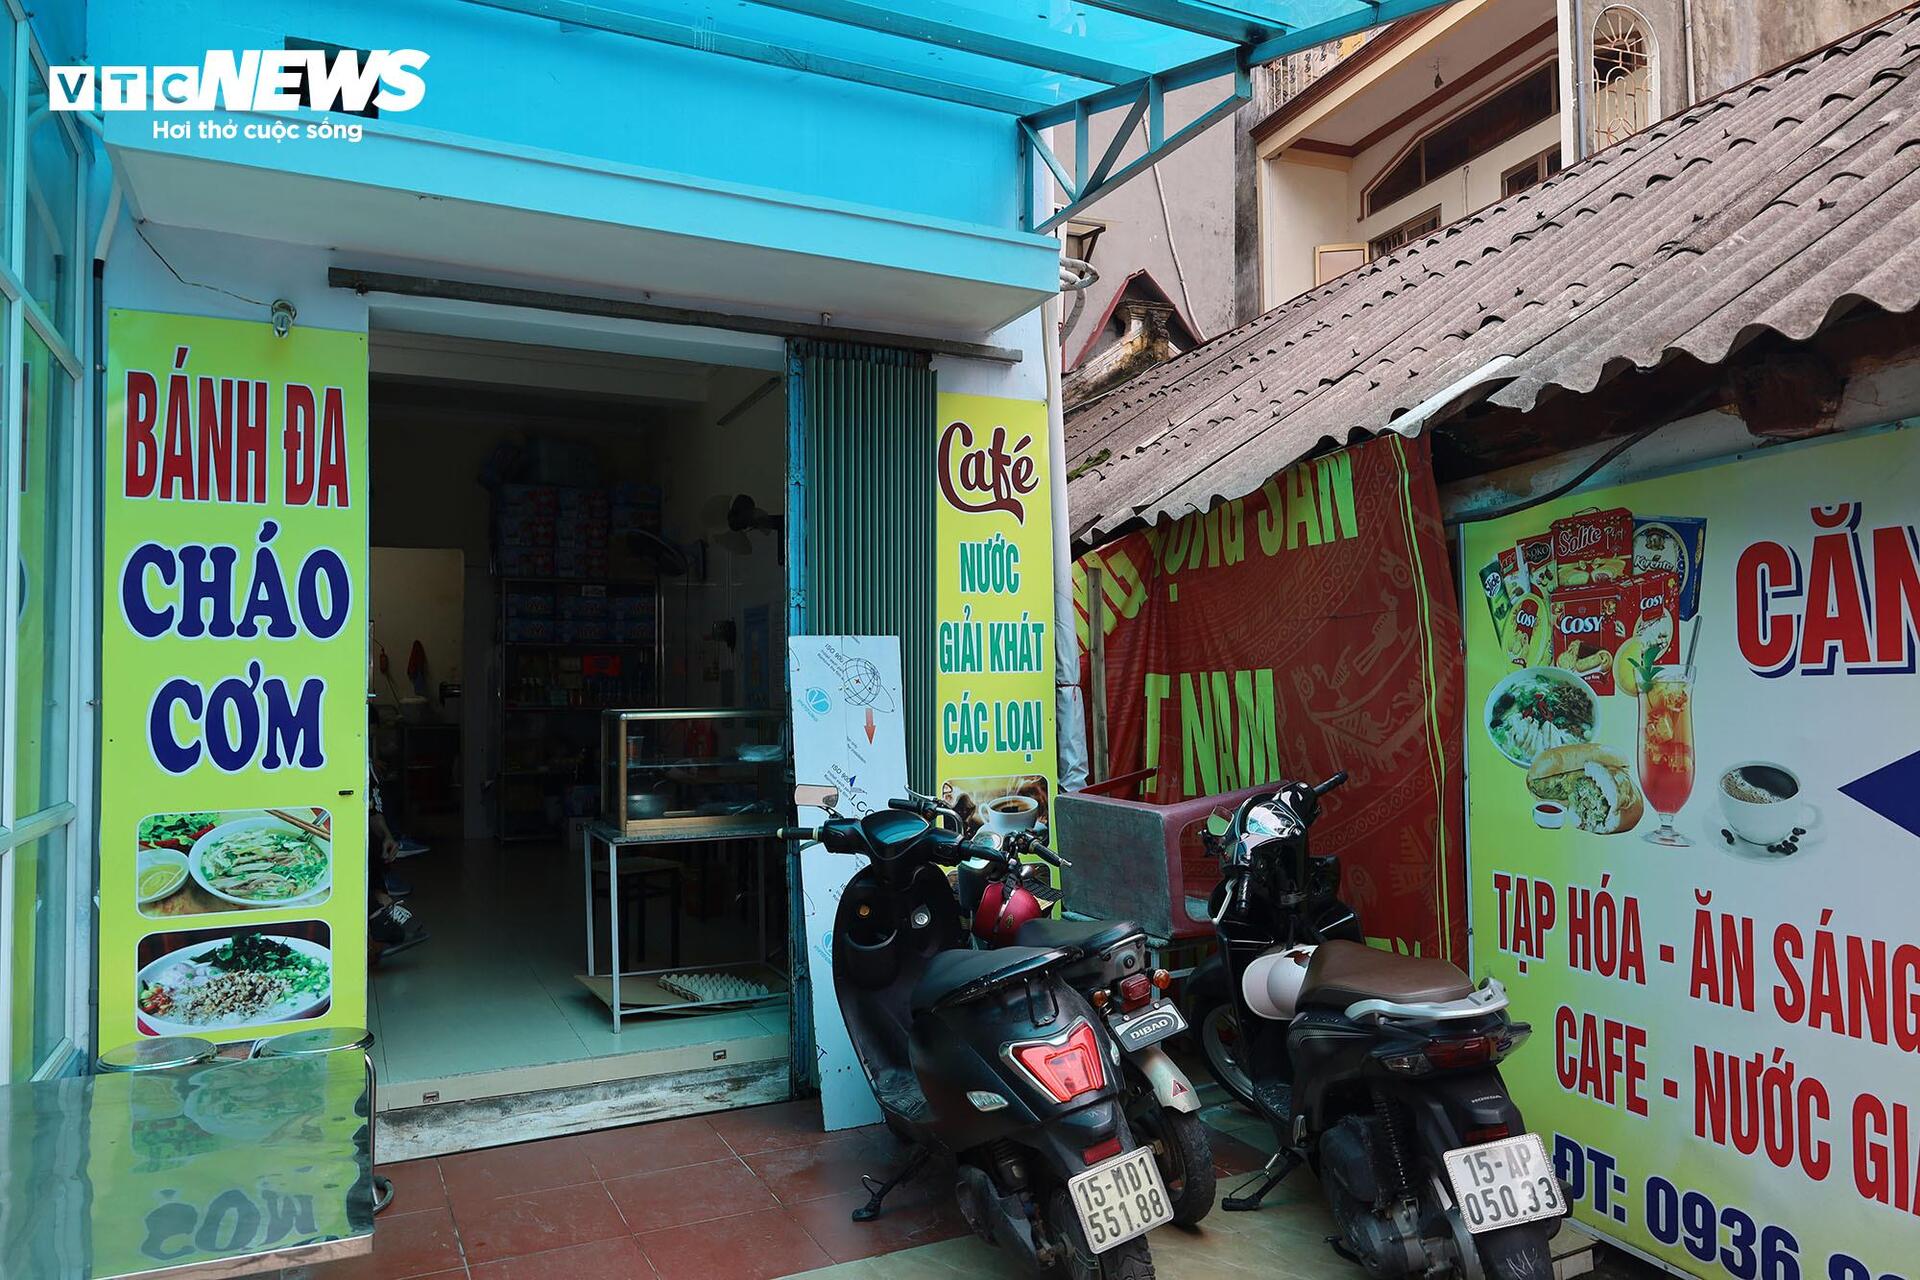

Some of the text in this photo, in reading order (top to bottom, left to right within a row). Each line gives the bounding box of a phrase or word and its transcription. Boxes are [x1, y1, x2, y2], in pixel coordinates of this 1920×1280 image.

[126, 348, 349, 507] BÁNH ĐA
[938, 422, 1041, 526] Café
[122, 520, 351, 641] CHÁO
[959, 533, 1020, 596] NƯỚC
[938, 605, 1045, 674] GIẢI KHÁT
[149, 660, 325, 774] CƠM
[942, 691, 988, 756] CÁC
[993, 700, 1043, 764] LOẠI
[1179, 667, 1282, 798] NAM
[1493, 873, 1557, 973] TẠP
[1567, 873, 1647, 986] HÓA
[1690, 888, 1756, 1013] ĂN
[1130, 1018, 1169, 1041] DIBAO
[1554, 1004, 1649, 1118] CAFE
[1693, 1044, 1833, 1183] NƯỚC
[1851, 1091, 1920, 1219] GI
[1088, 1188, 1165, 1244] 551.88
[1462, 1144, 1532, 1187] 15-AP
[1464, 1177, 1559, 1226] 050.33
[1551, 1131, 1801, 1280] ĐT: 0936
